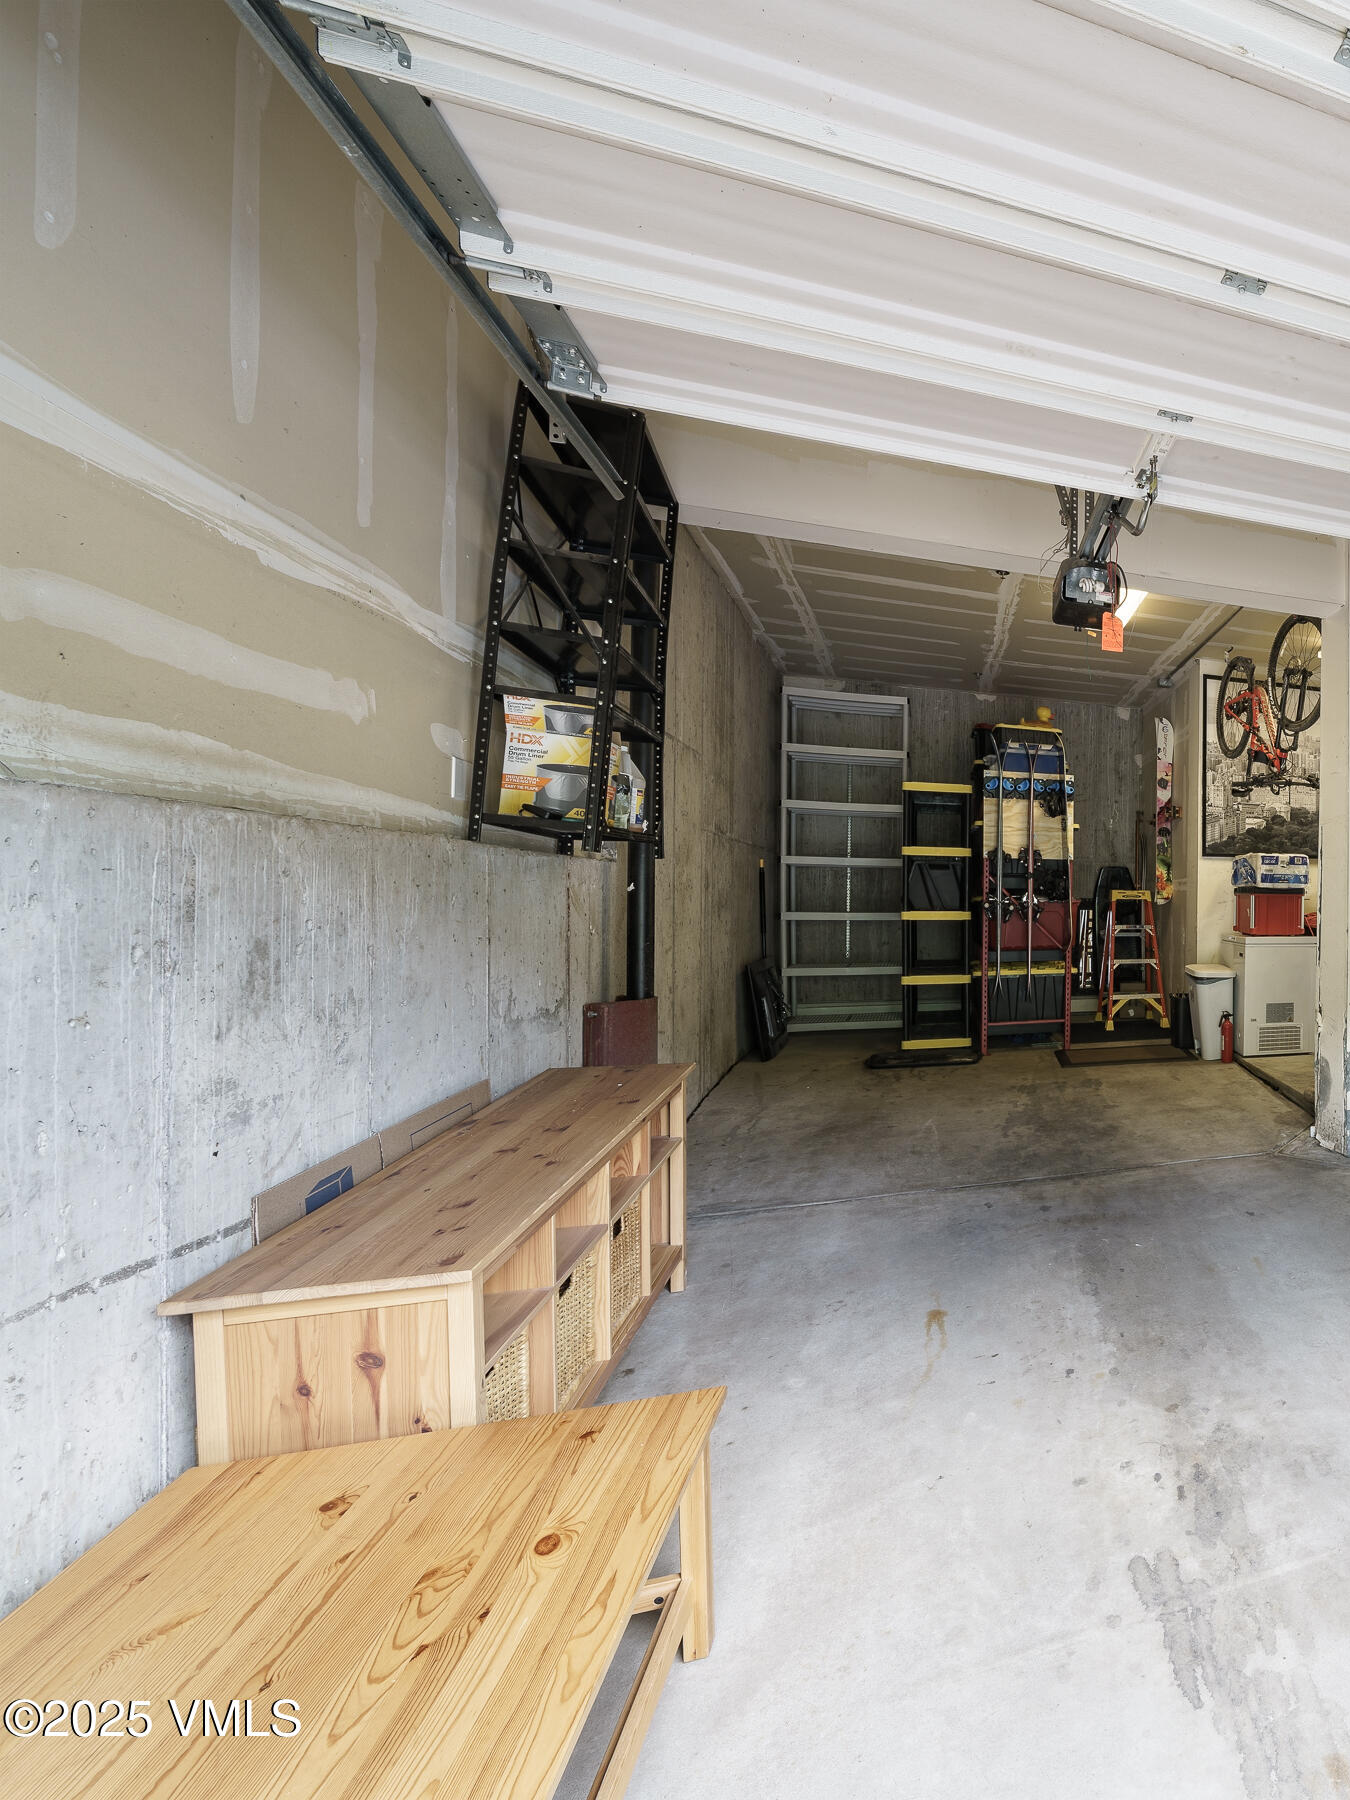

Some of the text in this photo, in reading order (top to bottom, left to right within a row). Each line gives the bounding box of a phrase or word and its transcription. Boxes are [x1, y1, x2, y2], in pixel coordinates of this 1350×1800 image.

[509, 731, 545, 746] HDX
[508, 745, 549, 755] Commercial
[505, 774, 541, 782] INDUSTRIAL
